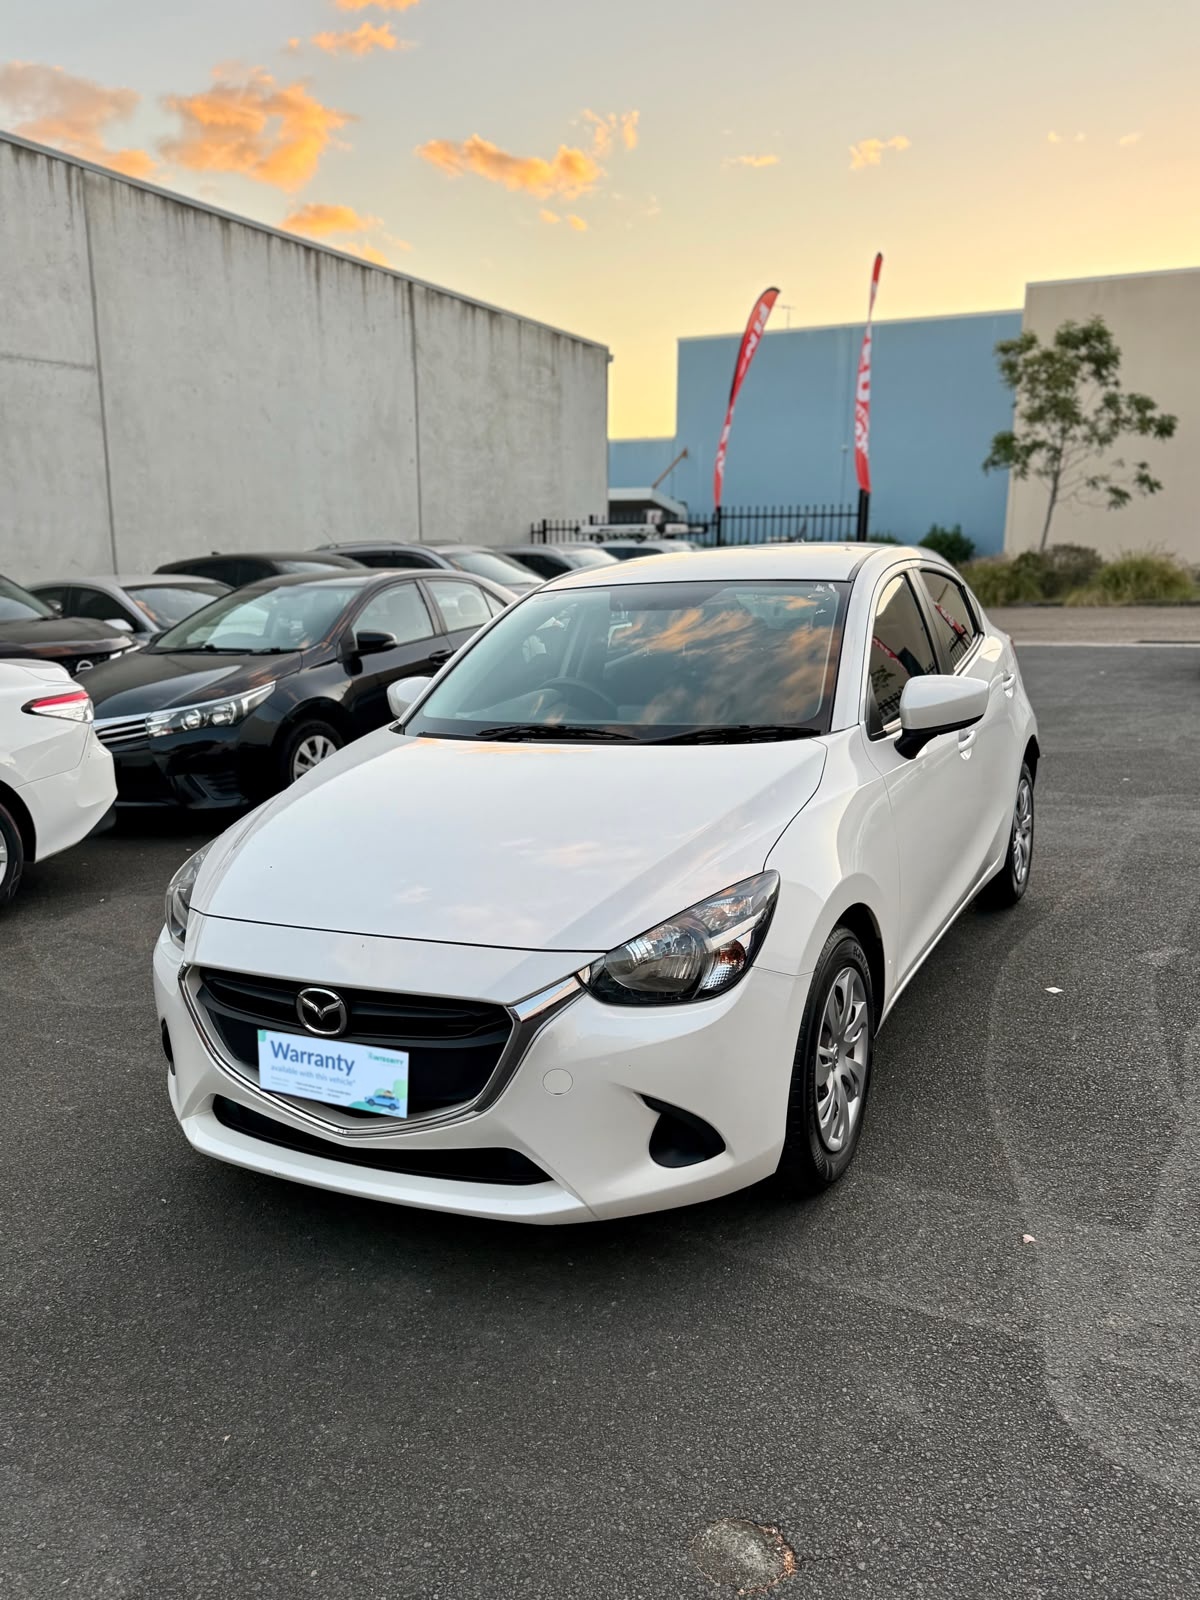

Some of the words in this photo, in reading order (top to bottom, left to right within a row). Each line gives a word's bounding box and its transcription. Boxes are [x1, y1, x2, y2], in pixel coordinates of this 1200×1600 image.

[270, 1040, 355, 1076] Warranty
[270, 1065, 298, 1076] available
[299, 1070, 314, 1079] with
[315, 1073, 328, 1082] this
